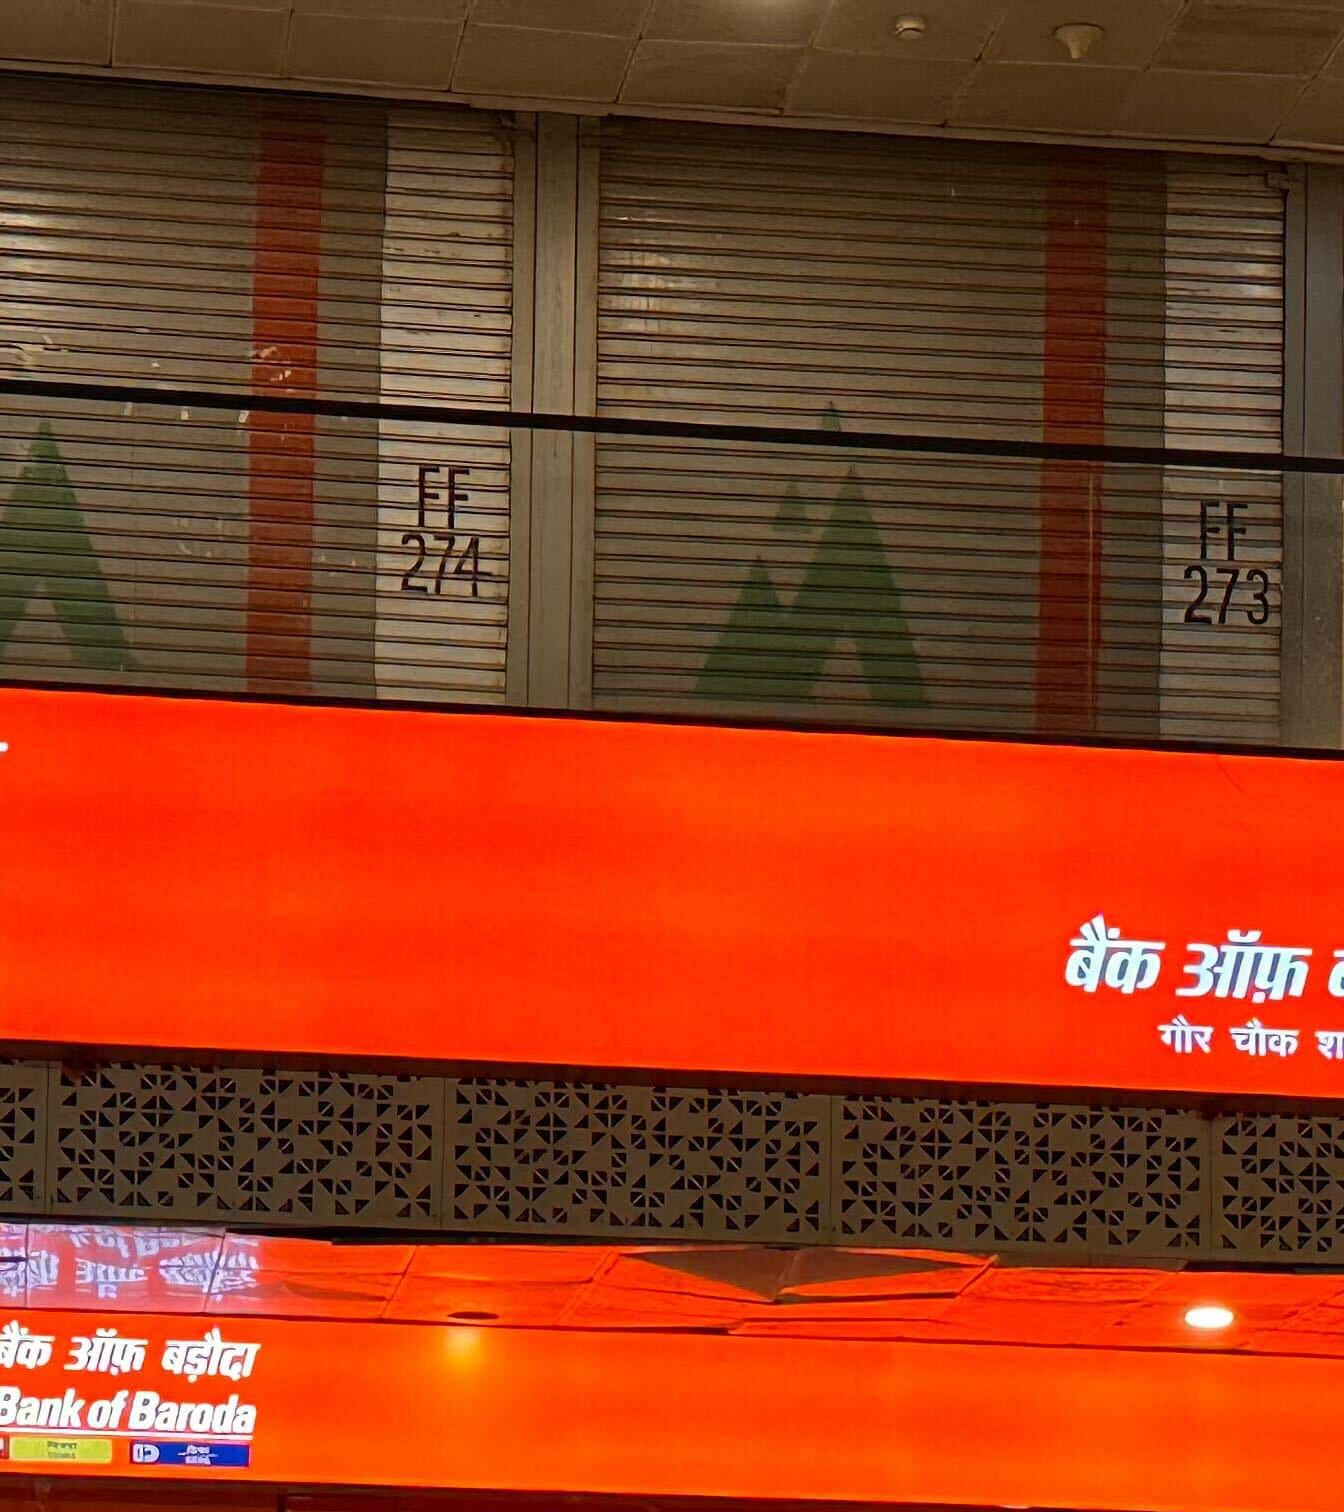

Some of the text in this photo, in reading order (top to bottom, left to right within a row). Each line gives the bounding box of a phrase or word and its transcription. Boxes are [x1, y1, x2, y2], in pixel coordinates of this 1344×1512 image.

[418, 464, 470, 529] FF
[1200, 500, 1248, 561] FF
[401, 534, 494, 597] 274
[1184, 565, 1269, 625] 273
[1065, 914, 1165, 993] बैंक
[1175, 929, 1313, 1003] ऑफ़
[1158, 1014, 1214, 1054] गौर
[1230, 1017, 1299, 1057] चौक
[64, 1328, 148, 1375] ऑफ़
[161, 1327, 261, 1383] बड़ौदा
[87, 1390, 129, 1430] of
[128, 1391, 256, 1434] Baroda
